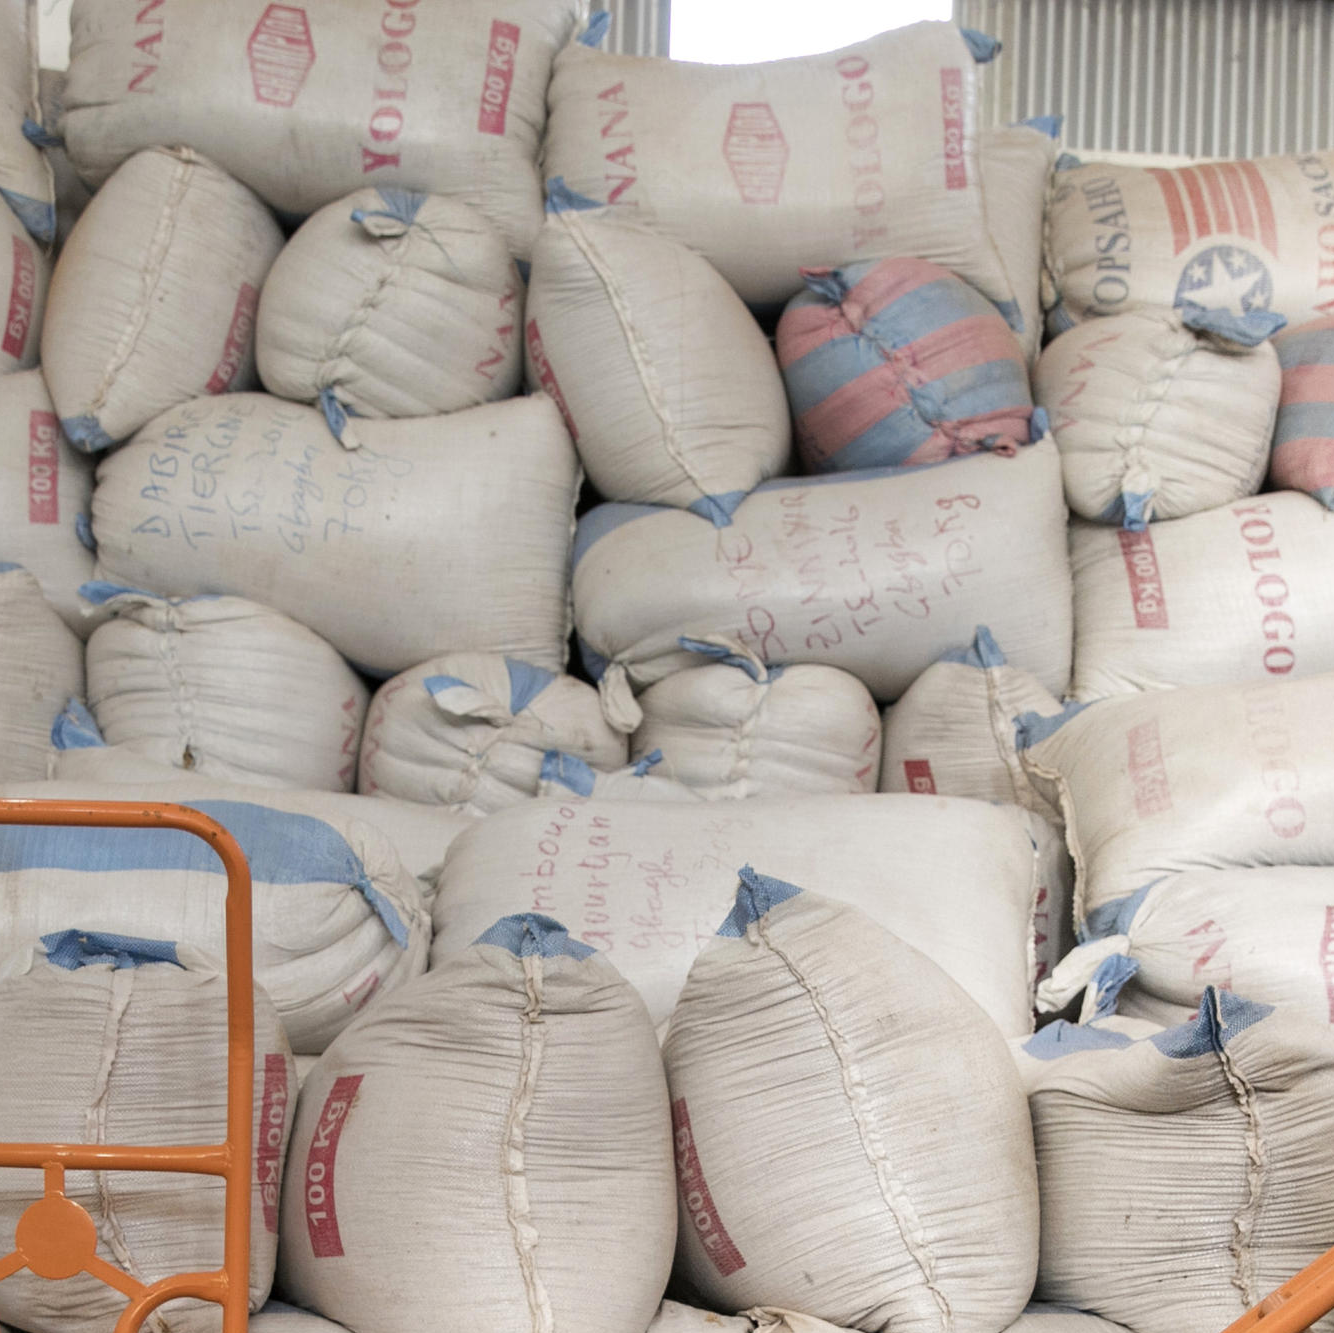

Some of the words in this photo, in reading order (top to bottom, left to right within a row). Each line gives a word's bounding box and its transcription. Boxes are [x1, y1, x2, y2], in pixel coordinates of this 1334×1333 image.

[492, 37, 514, 69] Kg
[484, 75, 503, 116] 100
[598, 82, 637, 204] NANA
[836, 55, 889, 249] YOLOGO
[17, 259, 33, 299] 100
[9, 301, 28, 340] Kg
[220, 340, 240, 382] Kg
[33, 460, 53, 506] 100
[1132, 543, 1149, 580] 100
[1135, 582, 1158, 617] Kg
[267, 1089, 285, 1144] 100
[318, 1098, 349, 1150] Kg
[264, 1156, 283, 1207] Kg
[308, 1157, 333, 1225] 100
[688, 1190, 721, 1251] 100
